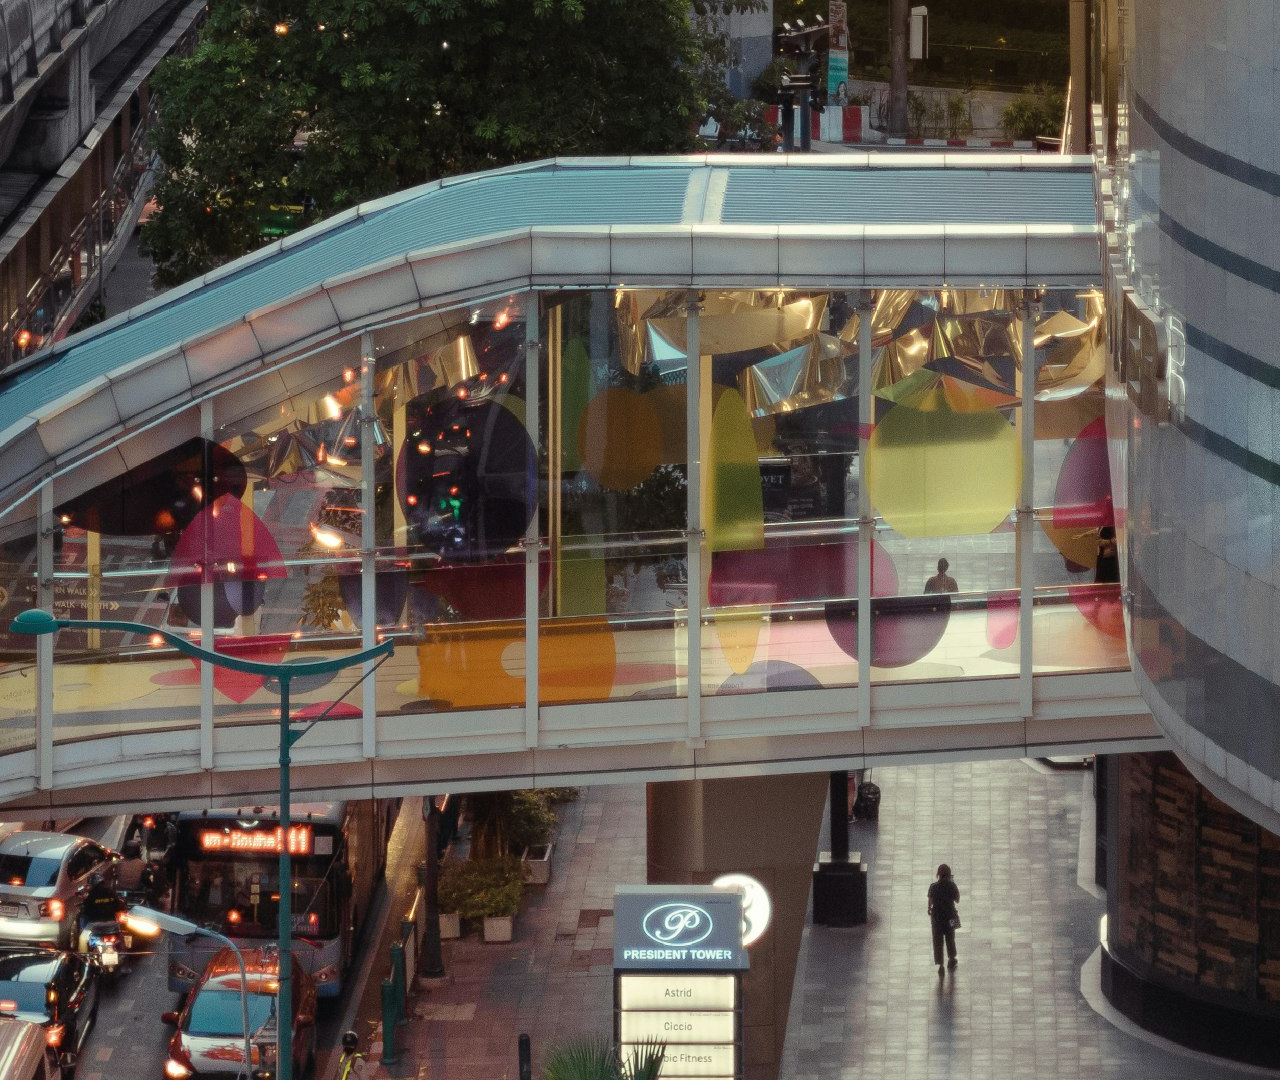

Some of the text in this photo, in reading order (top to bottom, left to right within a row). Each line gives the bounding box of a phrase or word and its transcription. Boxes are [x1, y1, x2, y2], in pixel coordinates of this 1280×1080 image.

[623, 949, 733, 960] PRESIDENT TOWER
[664, 988, 692, 998] Astrid
[664, 1021, 693, 1031] Ciccio
[679, 1053, 713, 1063] Fitness
